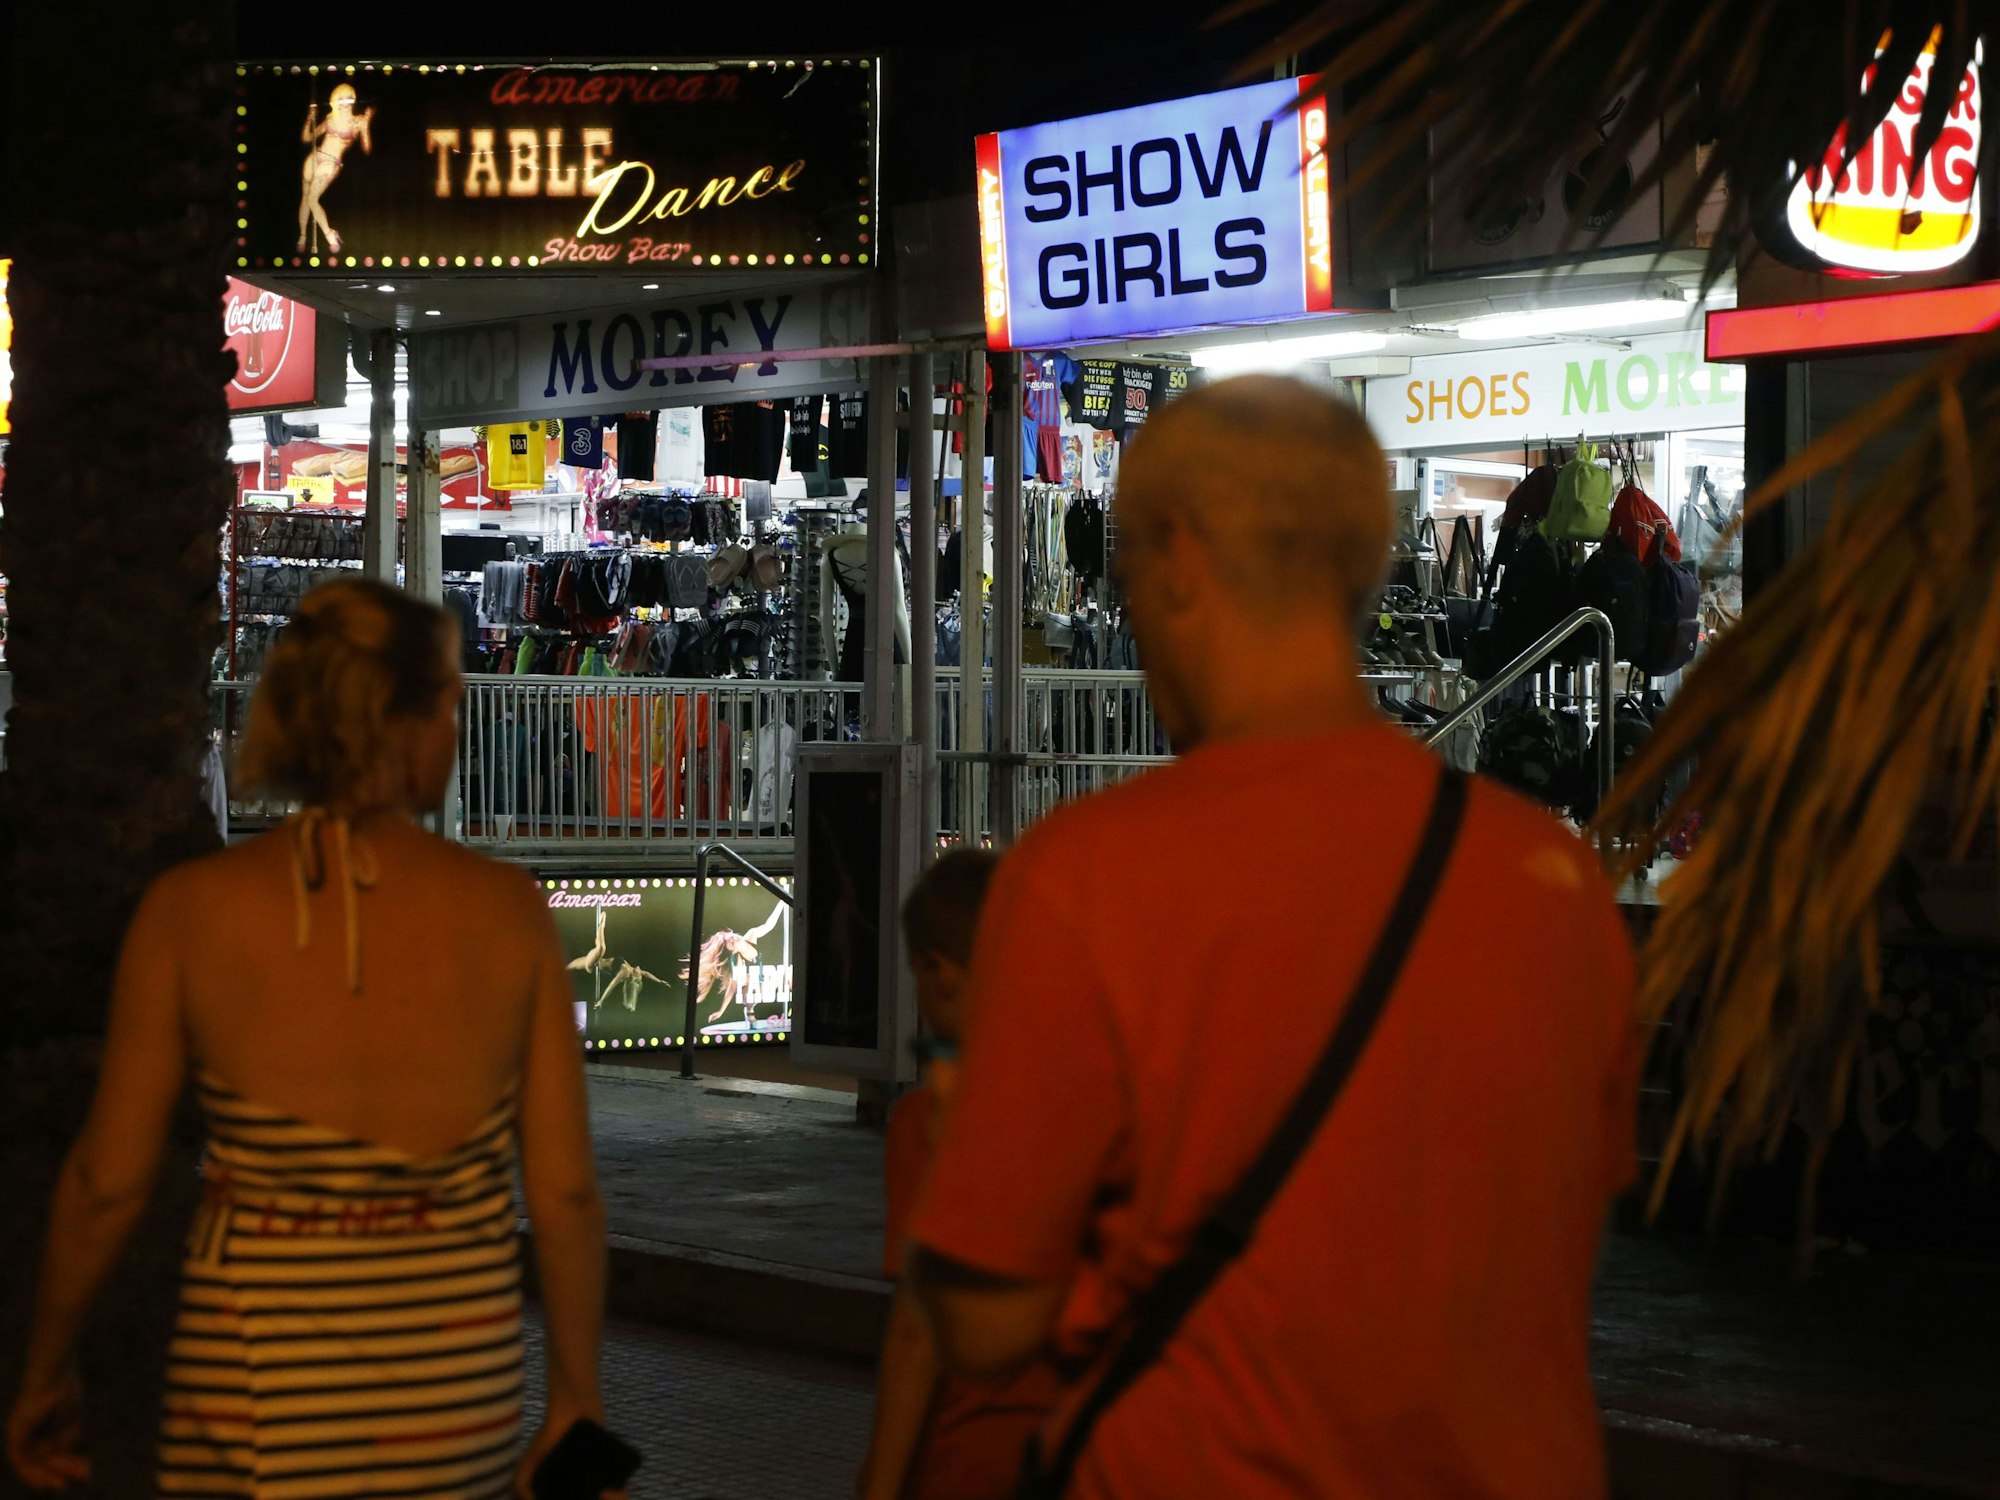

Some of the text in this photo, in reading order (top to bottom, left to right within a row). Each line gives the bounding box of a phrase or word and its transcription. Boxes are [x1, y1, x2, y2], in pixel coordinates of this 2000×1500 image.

[490, 68, 742, 106] American
[425, 126, 613, 198] TABLE
[1023, 119, 1275, 223] SHOW
[576, 158, 806, 238] Dance
[540, 236, 692, 265] Show Bar
[1037, 217, 1267, 310] GIRLS
[422, 329, 518, 408] SHOP
[543, 294, 793, 398] MOREY
[1083, 374, 1096, 383] DIE
[1131, 367, 1142, 379] bin
[1142, 369, 1153, 381] ein
[1168, 371, 1188, 389] 50
[1405, 350, 1740, 424] SHOES MORE
[511, 437, 527, 451] 1&1
[571, 428, 592, 456] 3
[547, 889, 642, 909] American
[732, 964, 793, 1004] TABL
